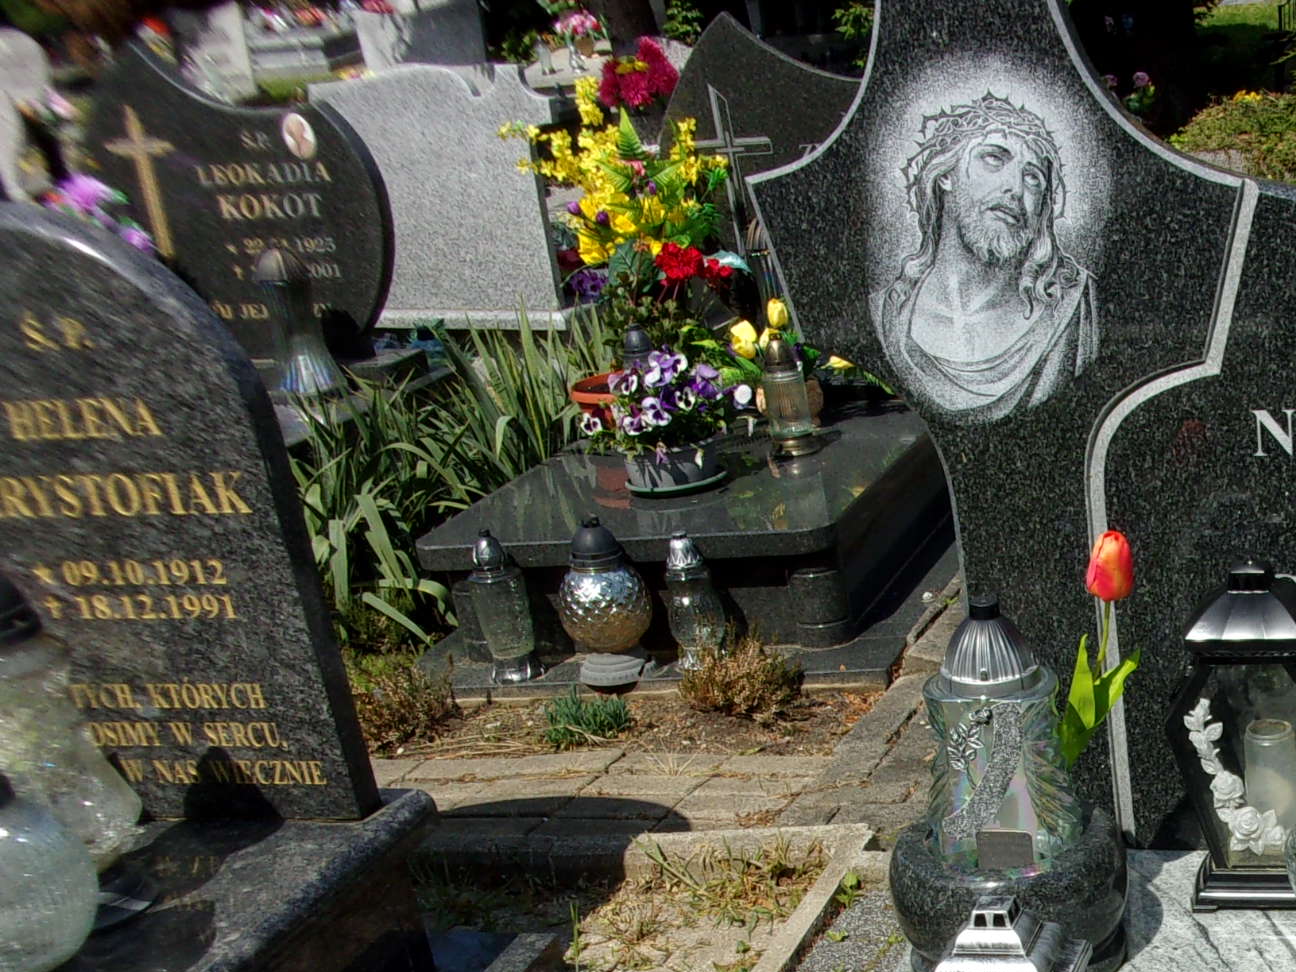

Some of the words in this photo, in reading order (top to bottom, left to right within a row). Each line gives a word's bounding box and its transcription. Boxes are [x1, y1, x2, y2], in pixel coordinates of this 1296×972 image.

[216, 192, 322, 220] KOKOT
[5, 398, 164, 441] HELENA
[0, 472, 253, 518] RYSTOFIAK
[62, 559, 227, 585] 09.10.1912
[75, 594, 238, 619] 18.12.1991
[148, 677, 266, 709] KTÓRYCH
[90, 721, 161, 747] OSIMY
[170, 722, 193, 747] W
[150, 759, 198, 784] NAS
